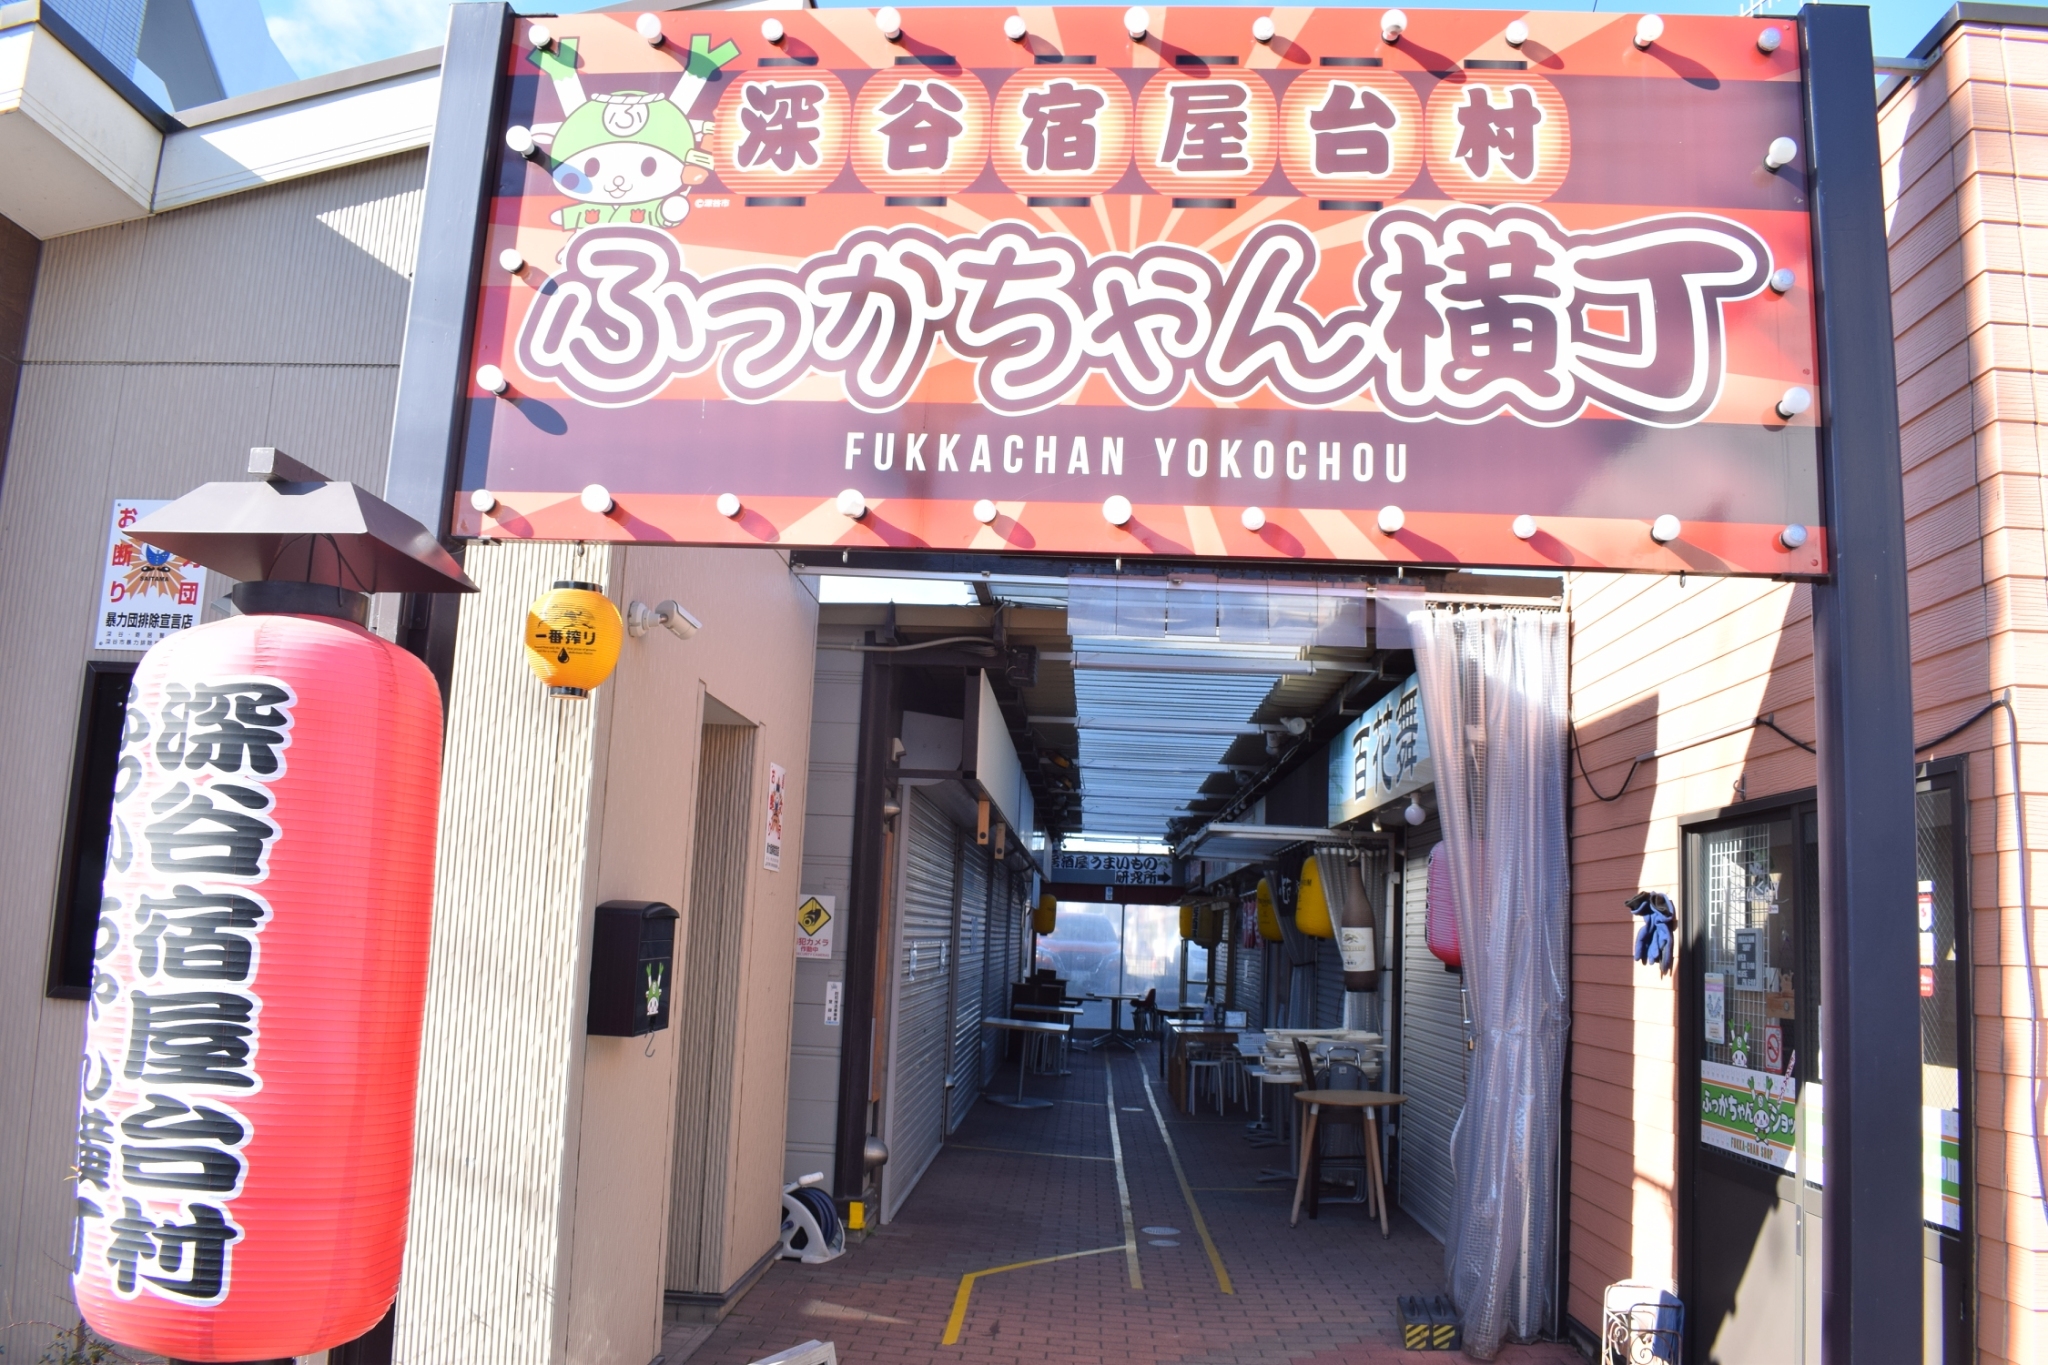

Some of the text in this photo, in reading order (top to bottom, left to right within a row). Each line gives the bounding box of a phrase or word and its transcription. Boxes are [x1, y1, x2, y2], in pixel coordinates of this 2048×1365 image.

[736, 81, 1543, 182] 深谷宿屋台村
[520, 208, 1768, 426] ふっかちゃん横丁
[845, 432, 1408, 483] FUKKACHAN YOKOCHOU
[105, 611, 193, 630] 暴力団排除宣言店
[535, 629, 596, 646] 一番搾り
[1353, 687, 1419, 802] 百花舞
[106, 682, 291, 1300] 深谷宿屋台村
[1702, 1090, 1754, 1124] ふっかちゃん
